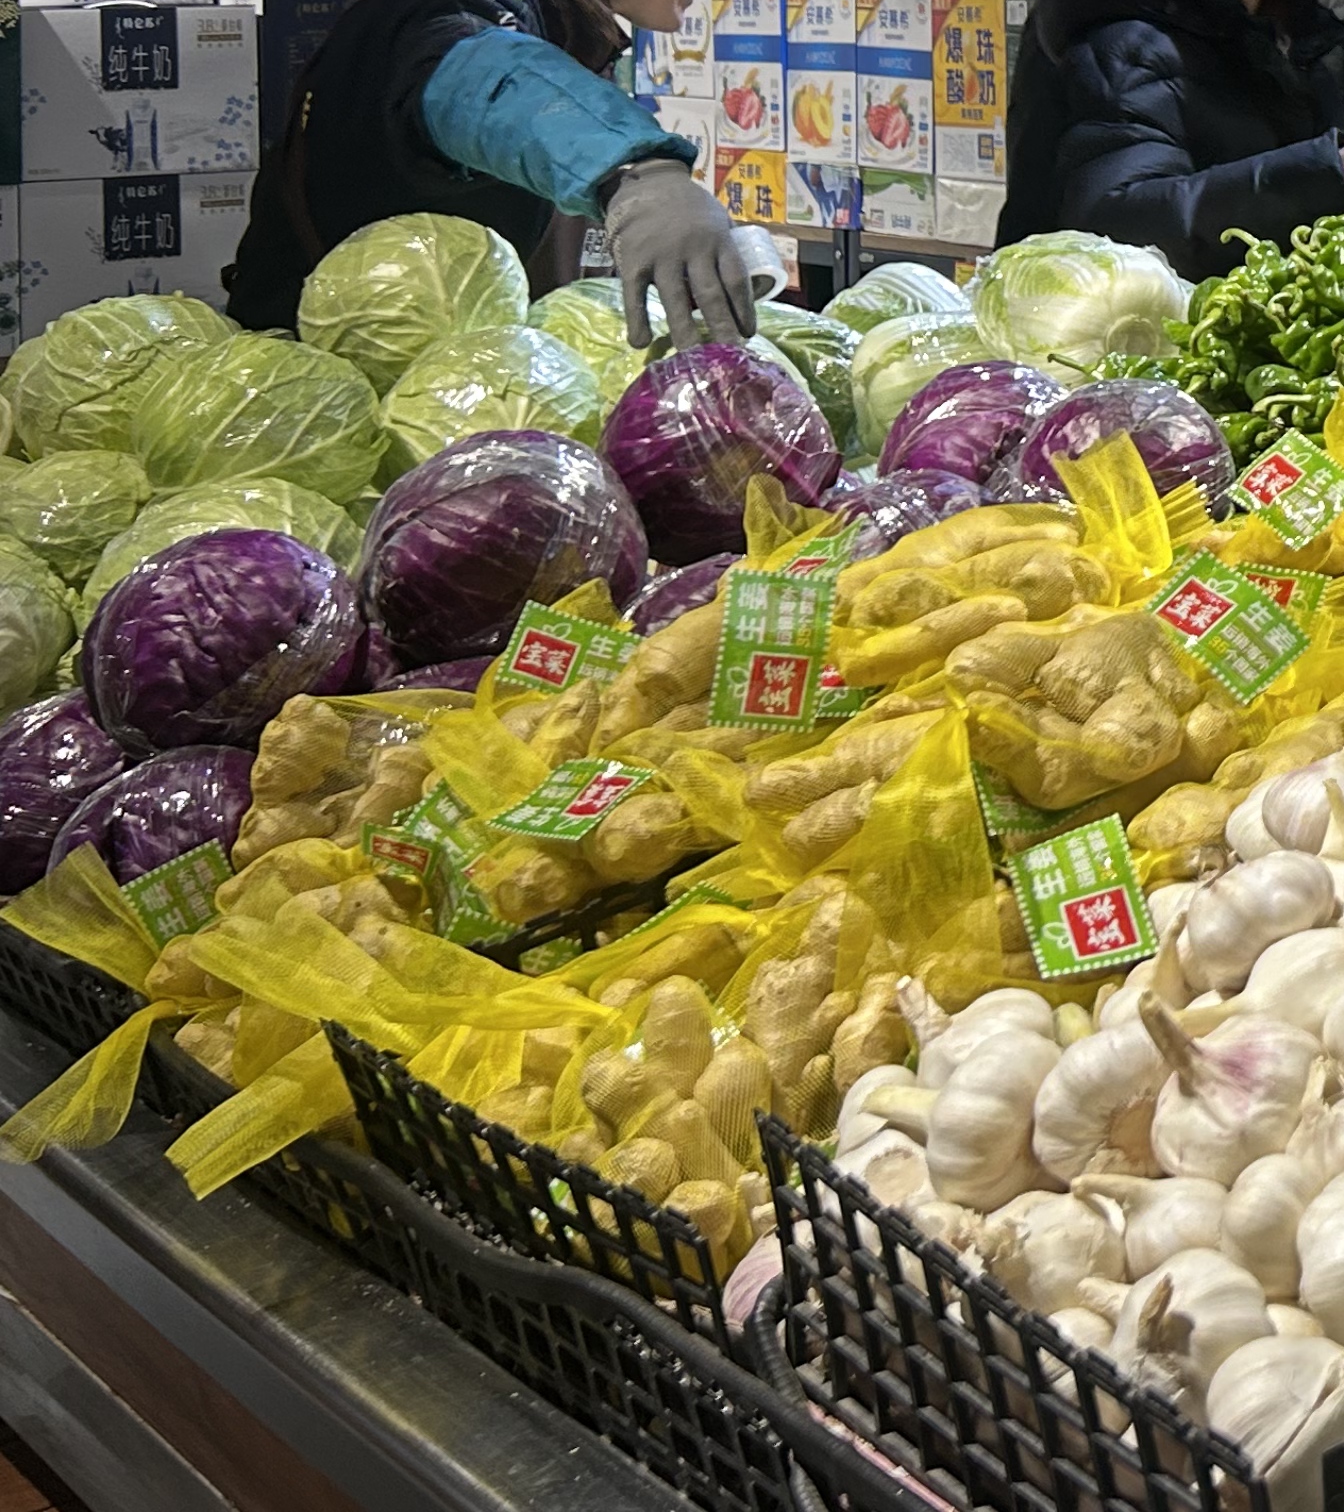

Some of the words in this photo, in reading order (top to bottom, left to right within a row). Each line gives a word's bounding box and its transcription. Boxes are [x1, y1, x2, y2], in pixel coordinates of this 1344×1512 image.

[108, 44, 173, 83] 纯牛奶
[111, 213, 175, 252] 纯牛奶
[1165, 592, 1223, 629] 宝菜
[1239, 600, 1298, 657] 生姜
[521, 641, 571, 675] 宝菜
[1077, 894, 1126, 951] 宝菜
